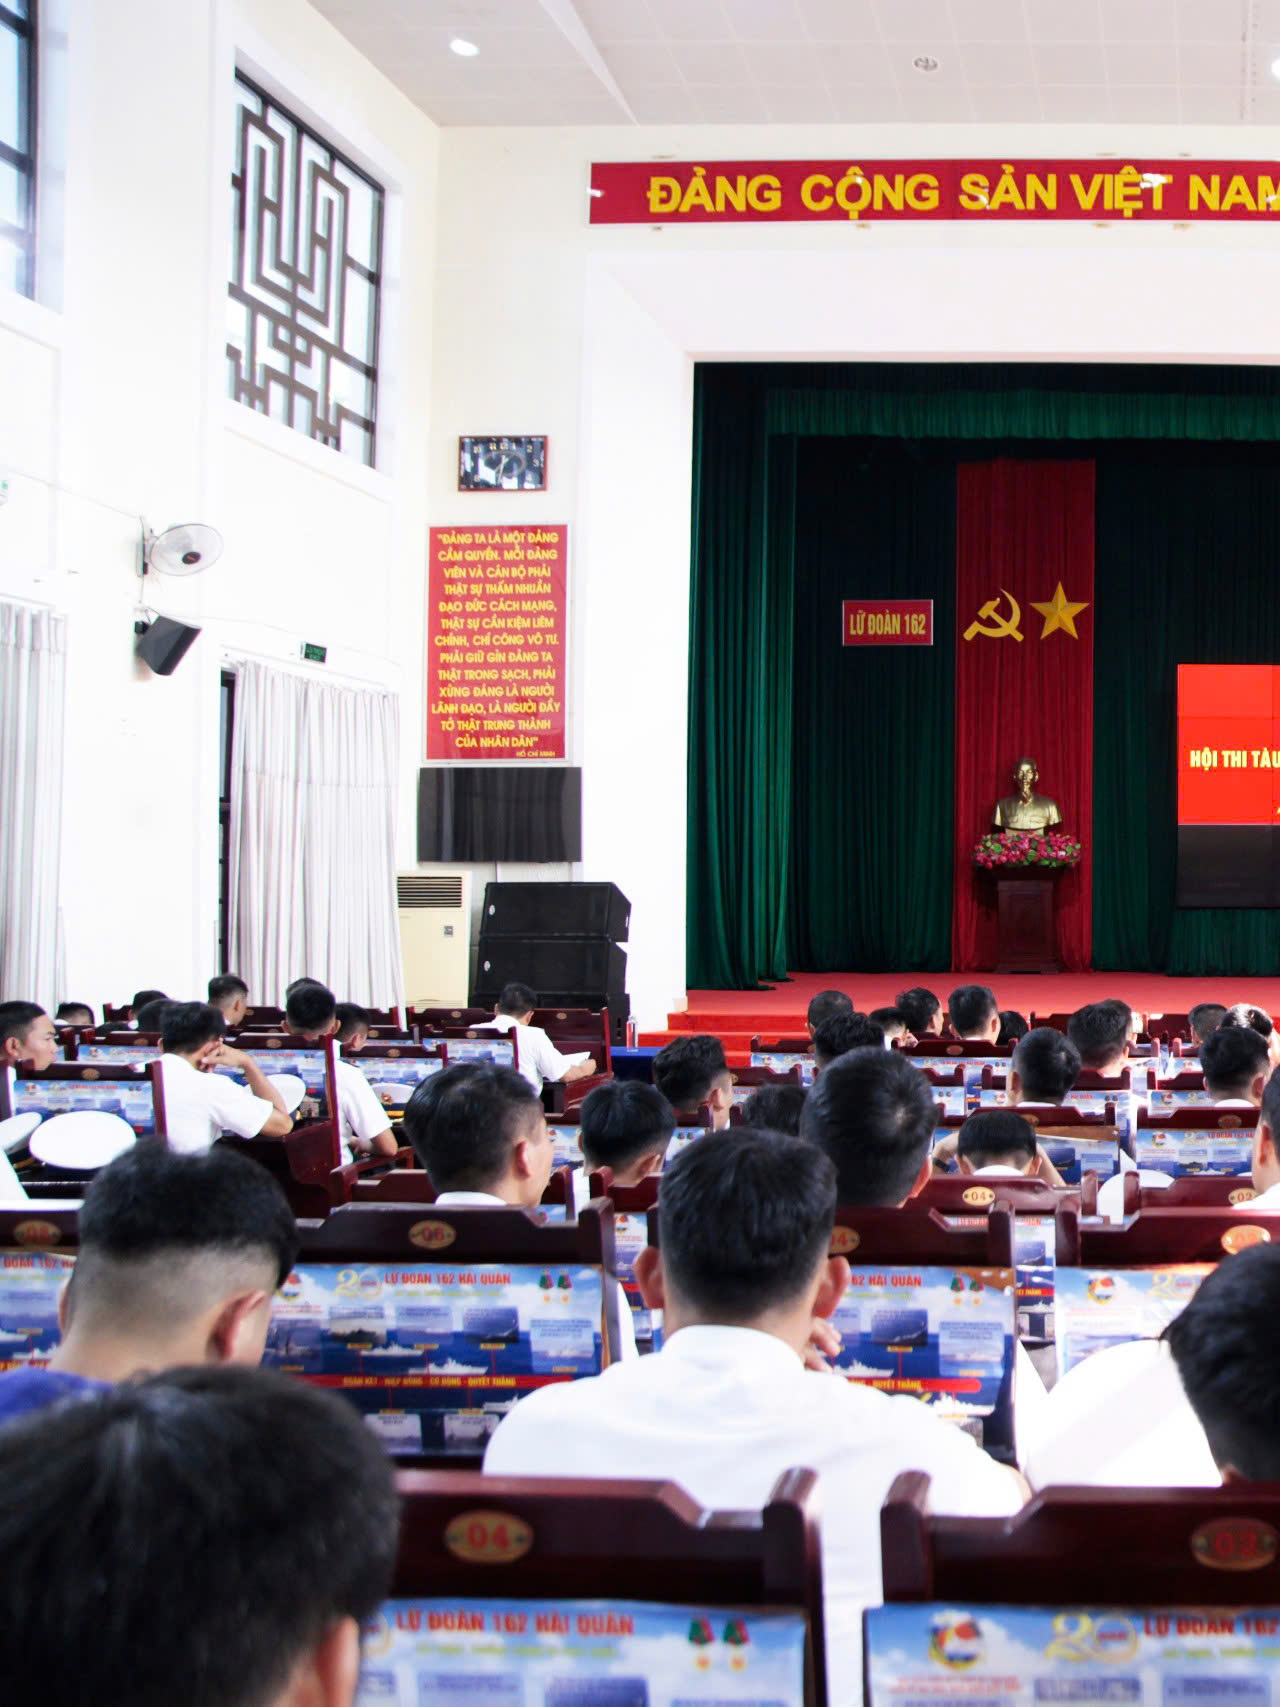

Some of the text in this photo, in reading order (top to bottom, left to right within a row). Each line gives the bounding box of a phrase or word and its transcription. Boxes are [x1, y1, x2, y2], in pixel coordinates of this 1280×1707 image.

[647, 167, 782, 213] ĐẢNG
[801, 165, 940, 219] CỘNG
[959, 163, 1058, 210] SẢN
[1070, 165, 1173, 217] VIỆT
[850, 609, 926, 635] LỮ ĐOÀN 162
[1190, 747, 1218, 771] HỘI
[1222, 751, 1247, 768] THI
[971, 1191, 987, 1201] 04
[466, 1522, 510, 1550] 04
